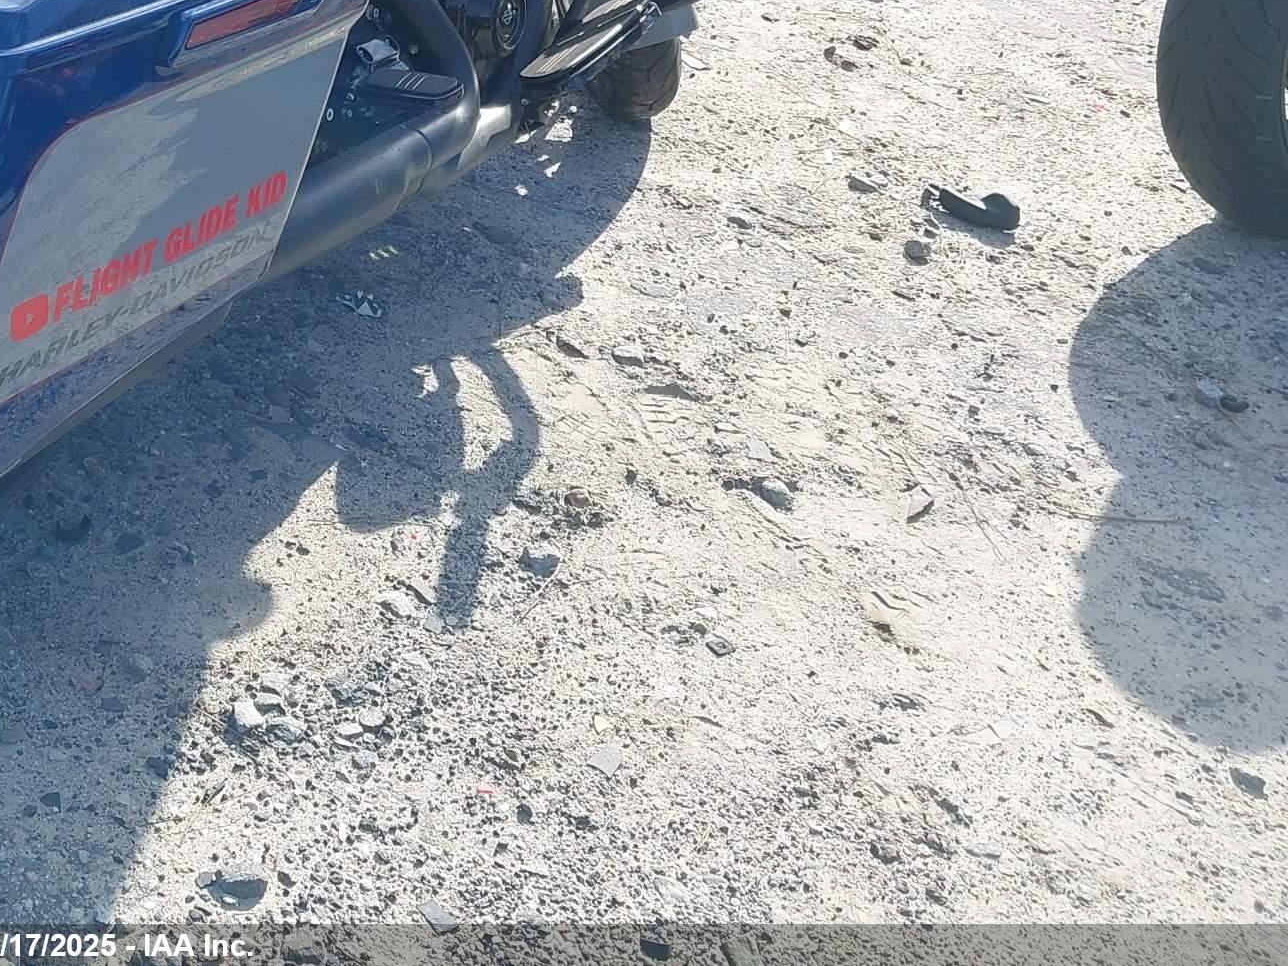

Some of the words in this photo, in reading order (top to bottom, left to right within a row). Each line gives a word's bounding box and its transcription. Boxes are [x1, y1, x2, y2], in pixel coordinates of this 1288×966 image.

[53, 239, 158, 323] FLIGHT
[163, 195, 240, 264] GLIDE
[246, 170, 289, 218] KID
